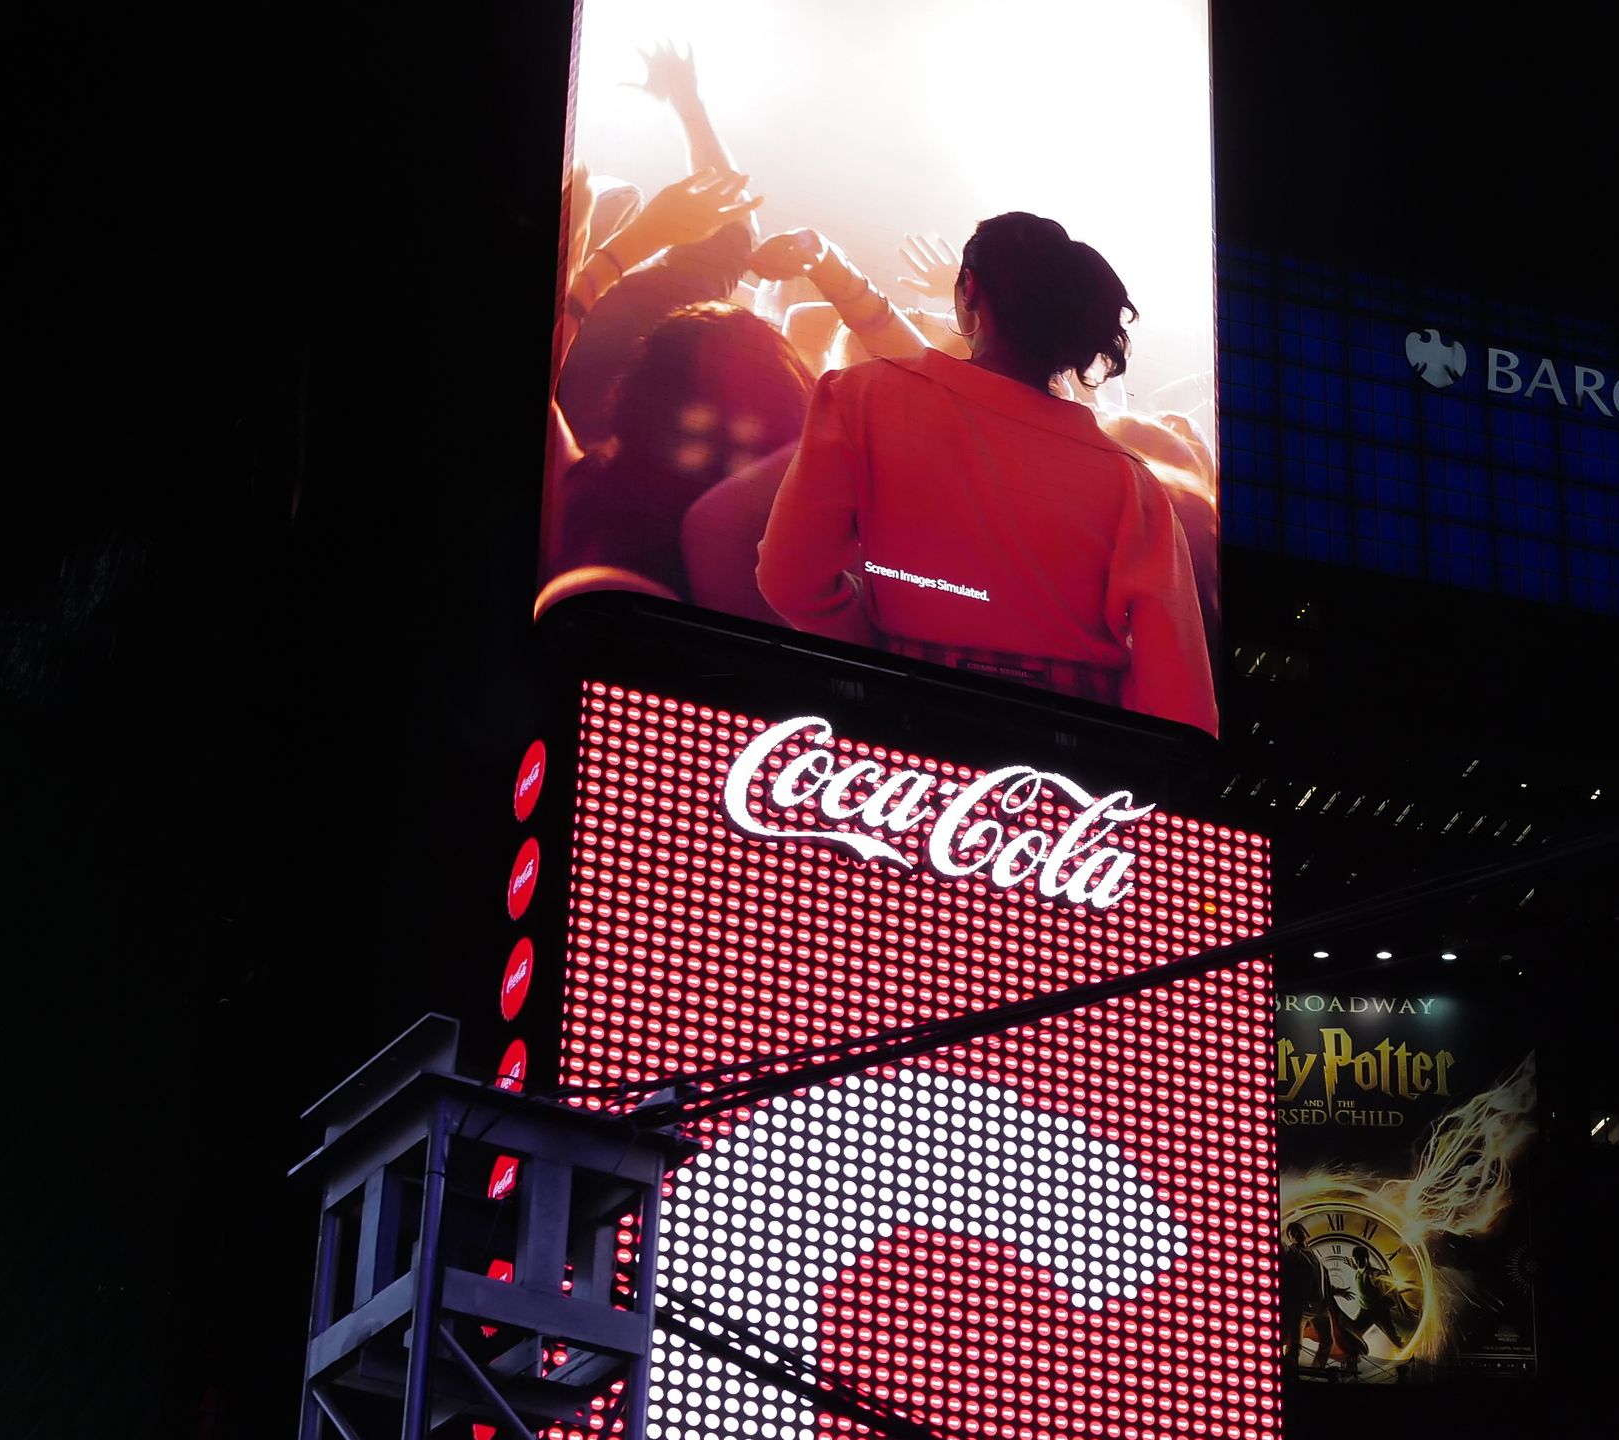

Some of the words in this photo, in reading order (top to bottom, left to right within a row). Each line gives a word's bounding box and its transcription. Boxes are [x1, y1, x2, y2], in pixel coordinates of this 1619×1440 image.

[865, 561, 899, 579] Screen
[900, 569, 937, 590] Images
[938, 578, 990, 602] Simulated.
[724, 715, 1157, 909] Coca-Cola
[1319, 1027, 1455, 1118] Potter
[1334, 1110, 1405, 1127] CHILD
[1337, 1100, 1356, 1108] THE
